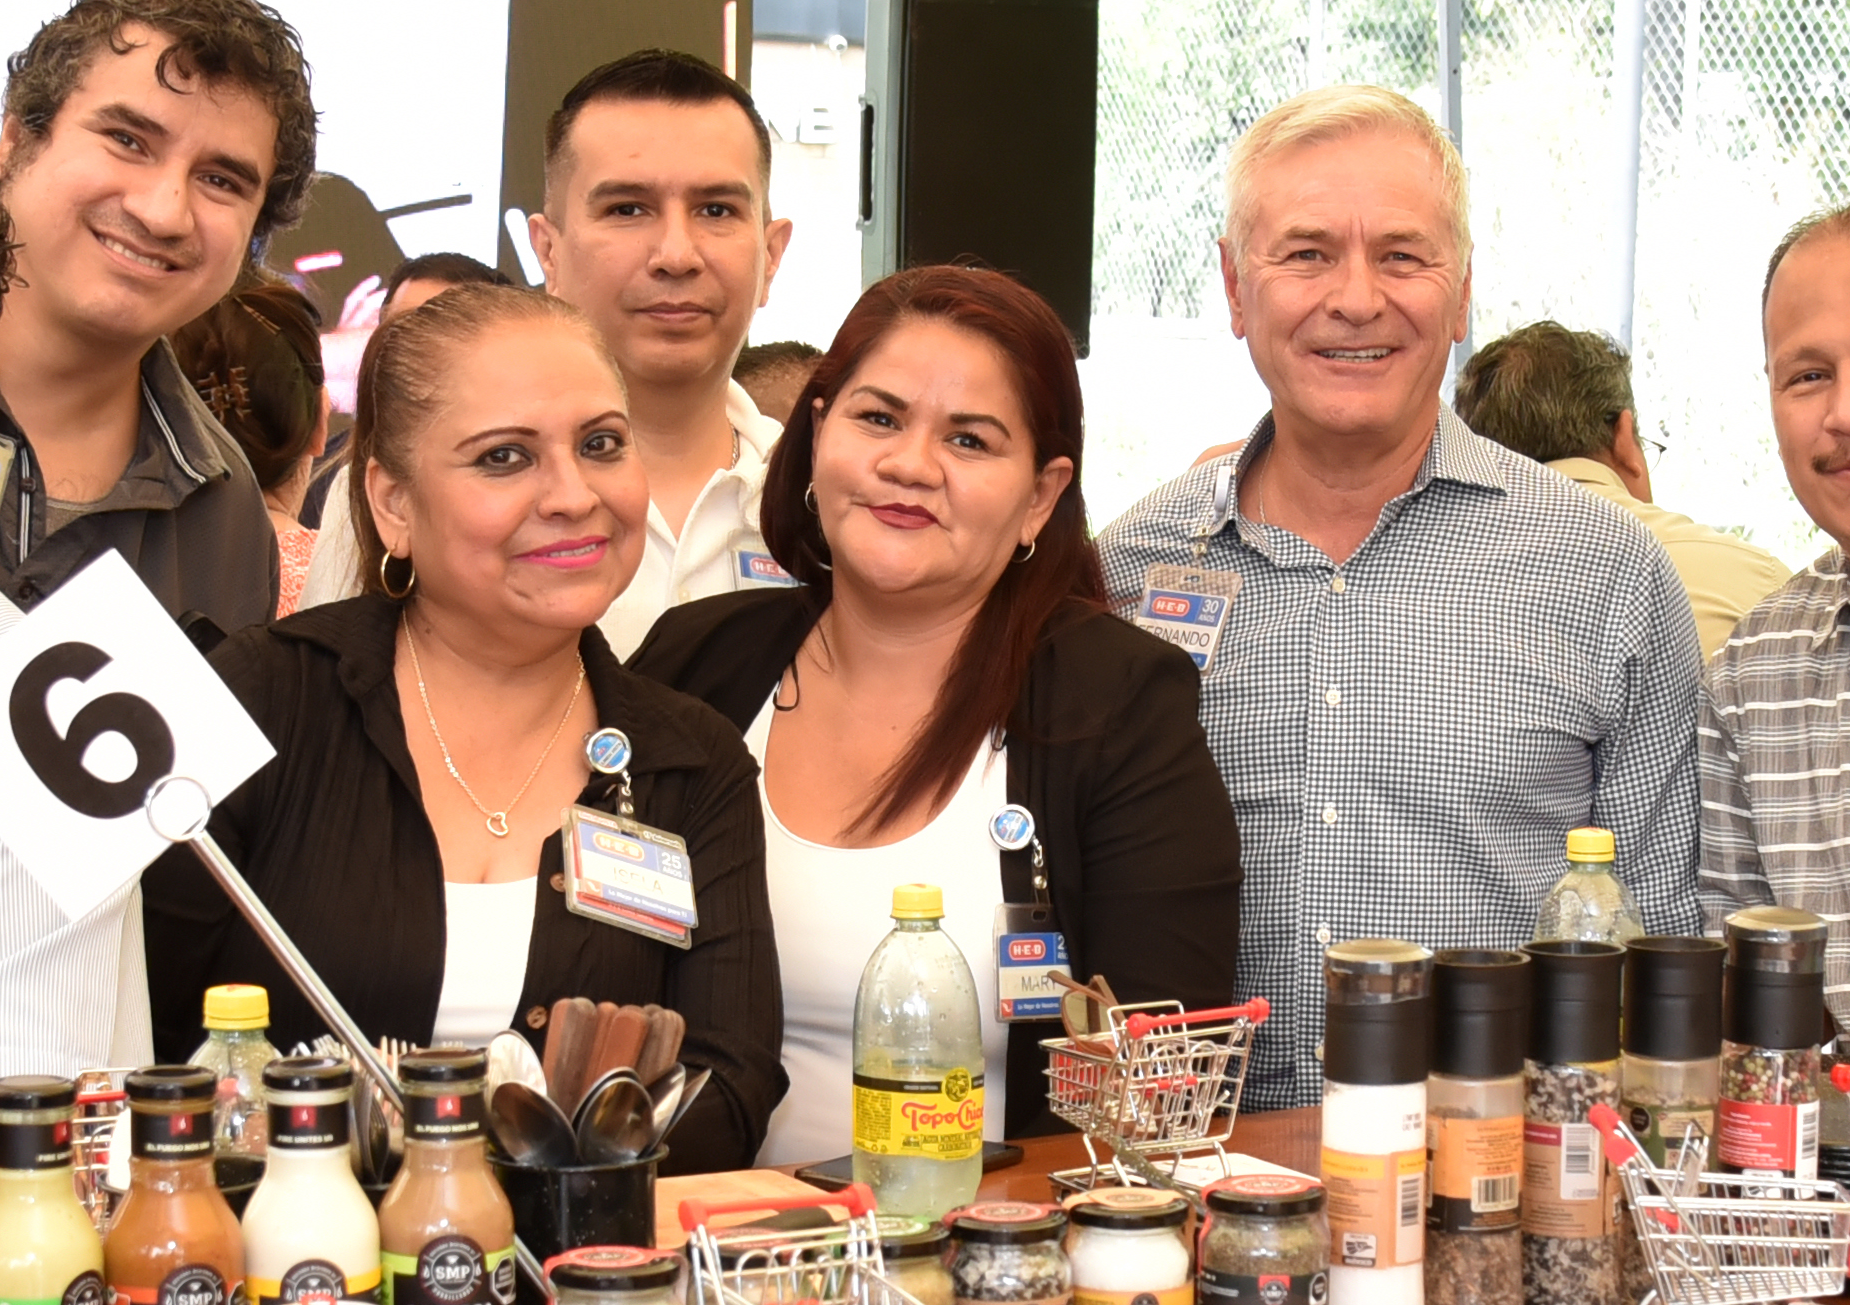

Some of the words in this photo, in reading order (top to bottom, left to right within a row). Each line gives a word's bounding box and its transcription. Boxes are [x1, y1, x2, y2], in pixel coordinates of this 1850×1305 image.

[1202, 599, 1219, 613] 30
[8, 641, 175, 820] 6
[662, 851, 681, 869] 25
[614, 867, 664, 894] ISELA
[1057, 935, 1066, 949] 2
[901, 1101, 955, 1132] Topo
[435, 1266, 471, 1281] SMP
